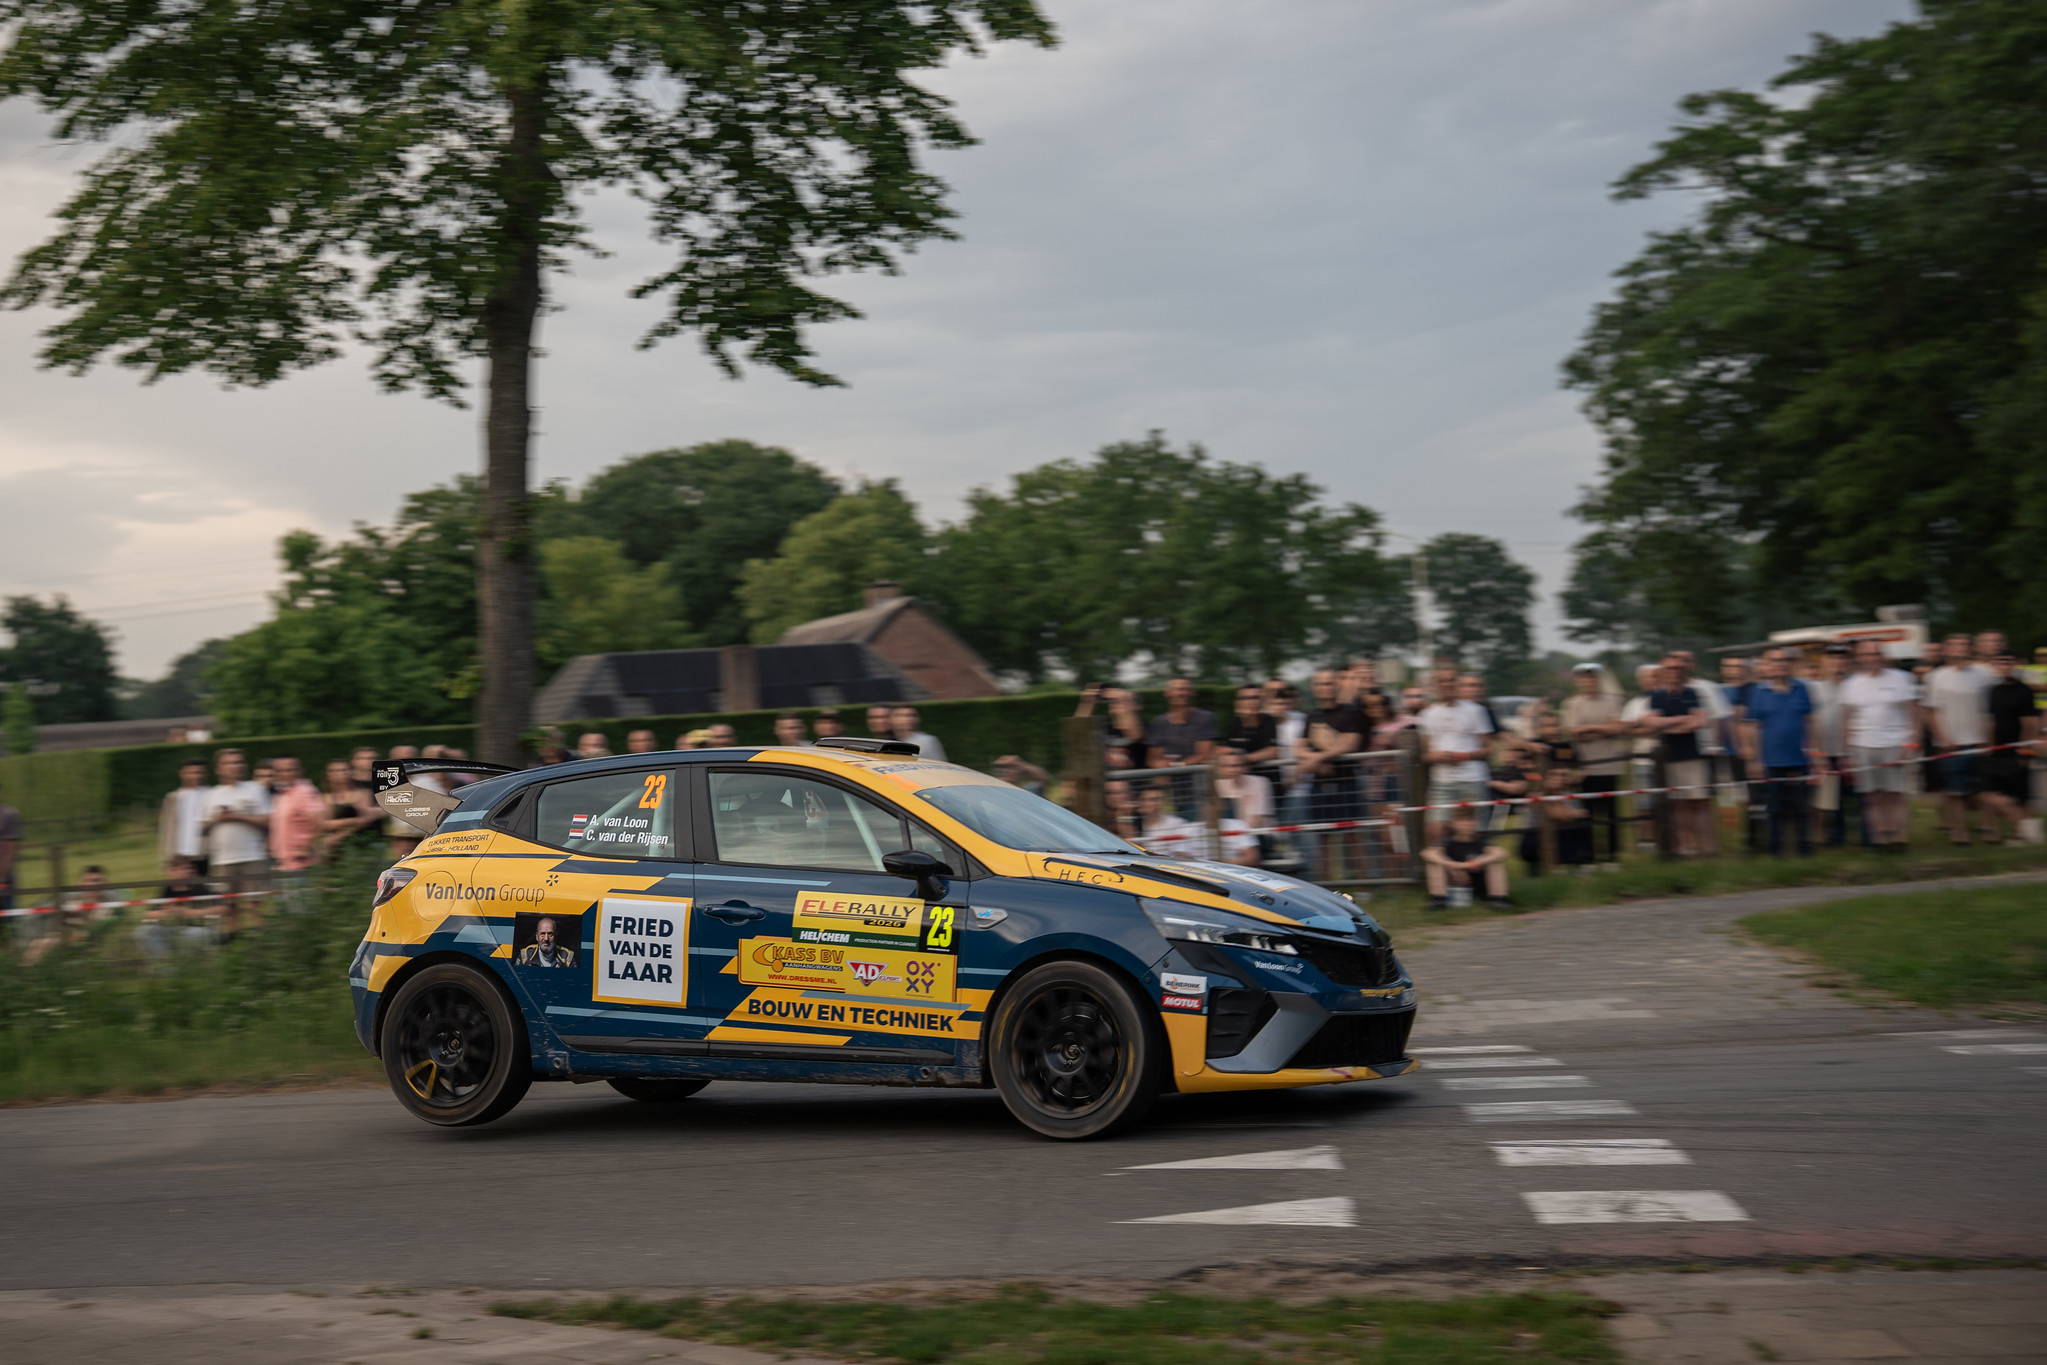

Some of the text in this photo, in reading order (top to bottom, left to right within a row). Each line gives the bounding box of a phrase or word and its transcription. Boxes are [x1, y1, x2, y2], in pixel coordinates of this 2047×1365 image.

[387, 766, 400, 786] 3
[638, 774, 667, 810] 23
[588, 814, 649, 829] A. van Loon
[451, 834, 490, 843] TRANSPORT
[586, 829, 669, 846] C. van der Rijsen
[499, 884, 545, 907] Group
[609, 915, 674, 938] FRIED
[868, 919, 901, 928] 2026
[926, 905, 955, 948] 23
[608, 940, 672, 959] VAN DE
[772, 945, 844, 964] KASS BV
[608, 960, 673, 984] LAAR
[784, 962, 842, 971] AANHANGWAGENS
[854, 964, 880, 980] AD
[768, 974, 837, 984] WWW.DRESSME.NL
[1163, 997, 1200, 1008] MOTUL
[748, 998, 954, 1032] BOUW EN TECHNIEK
